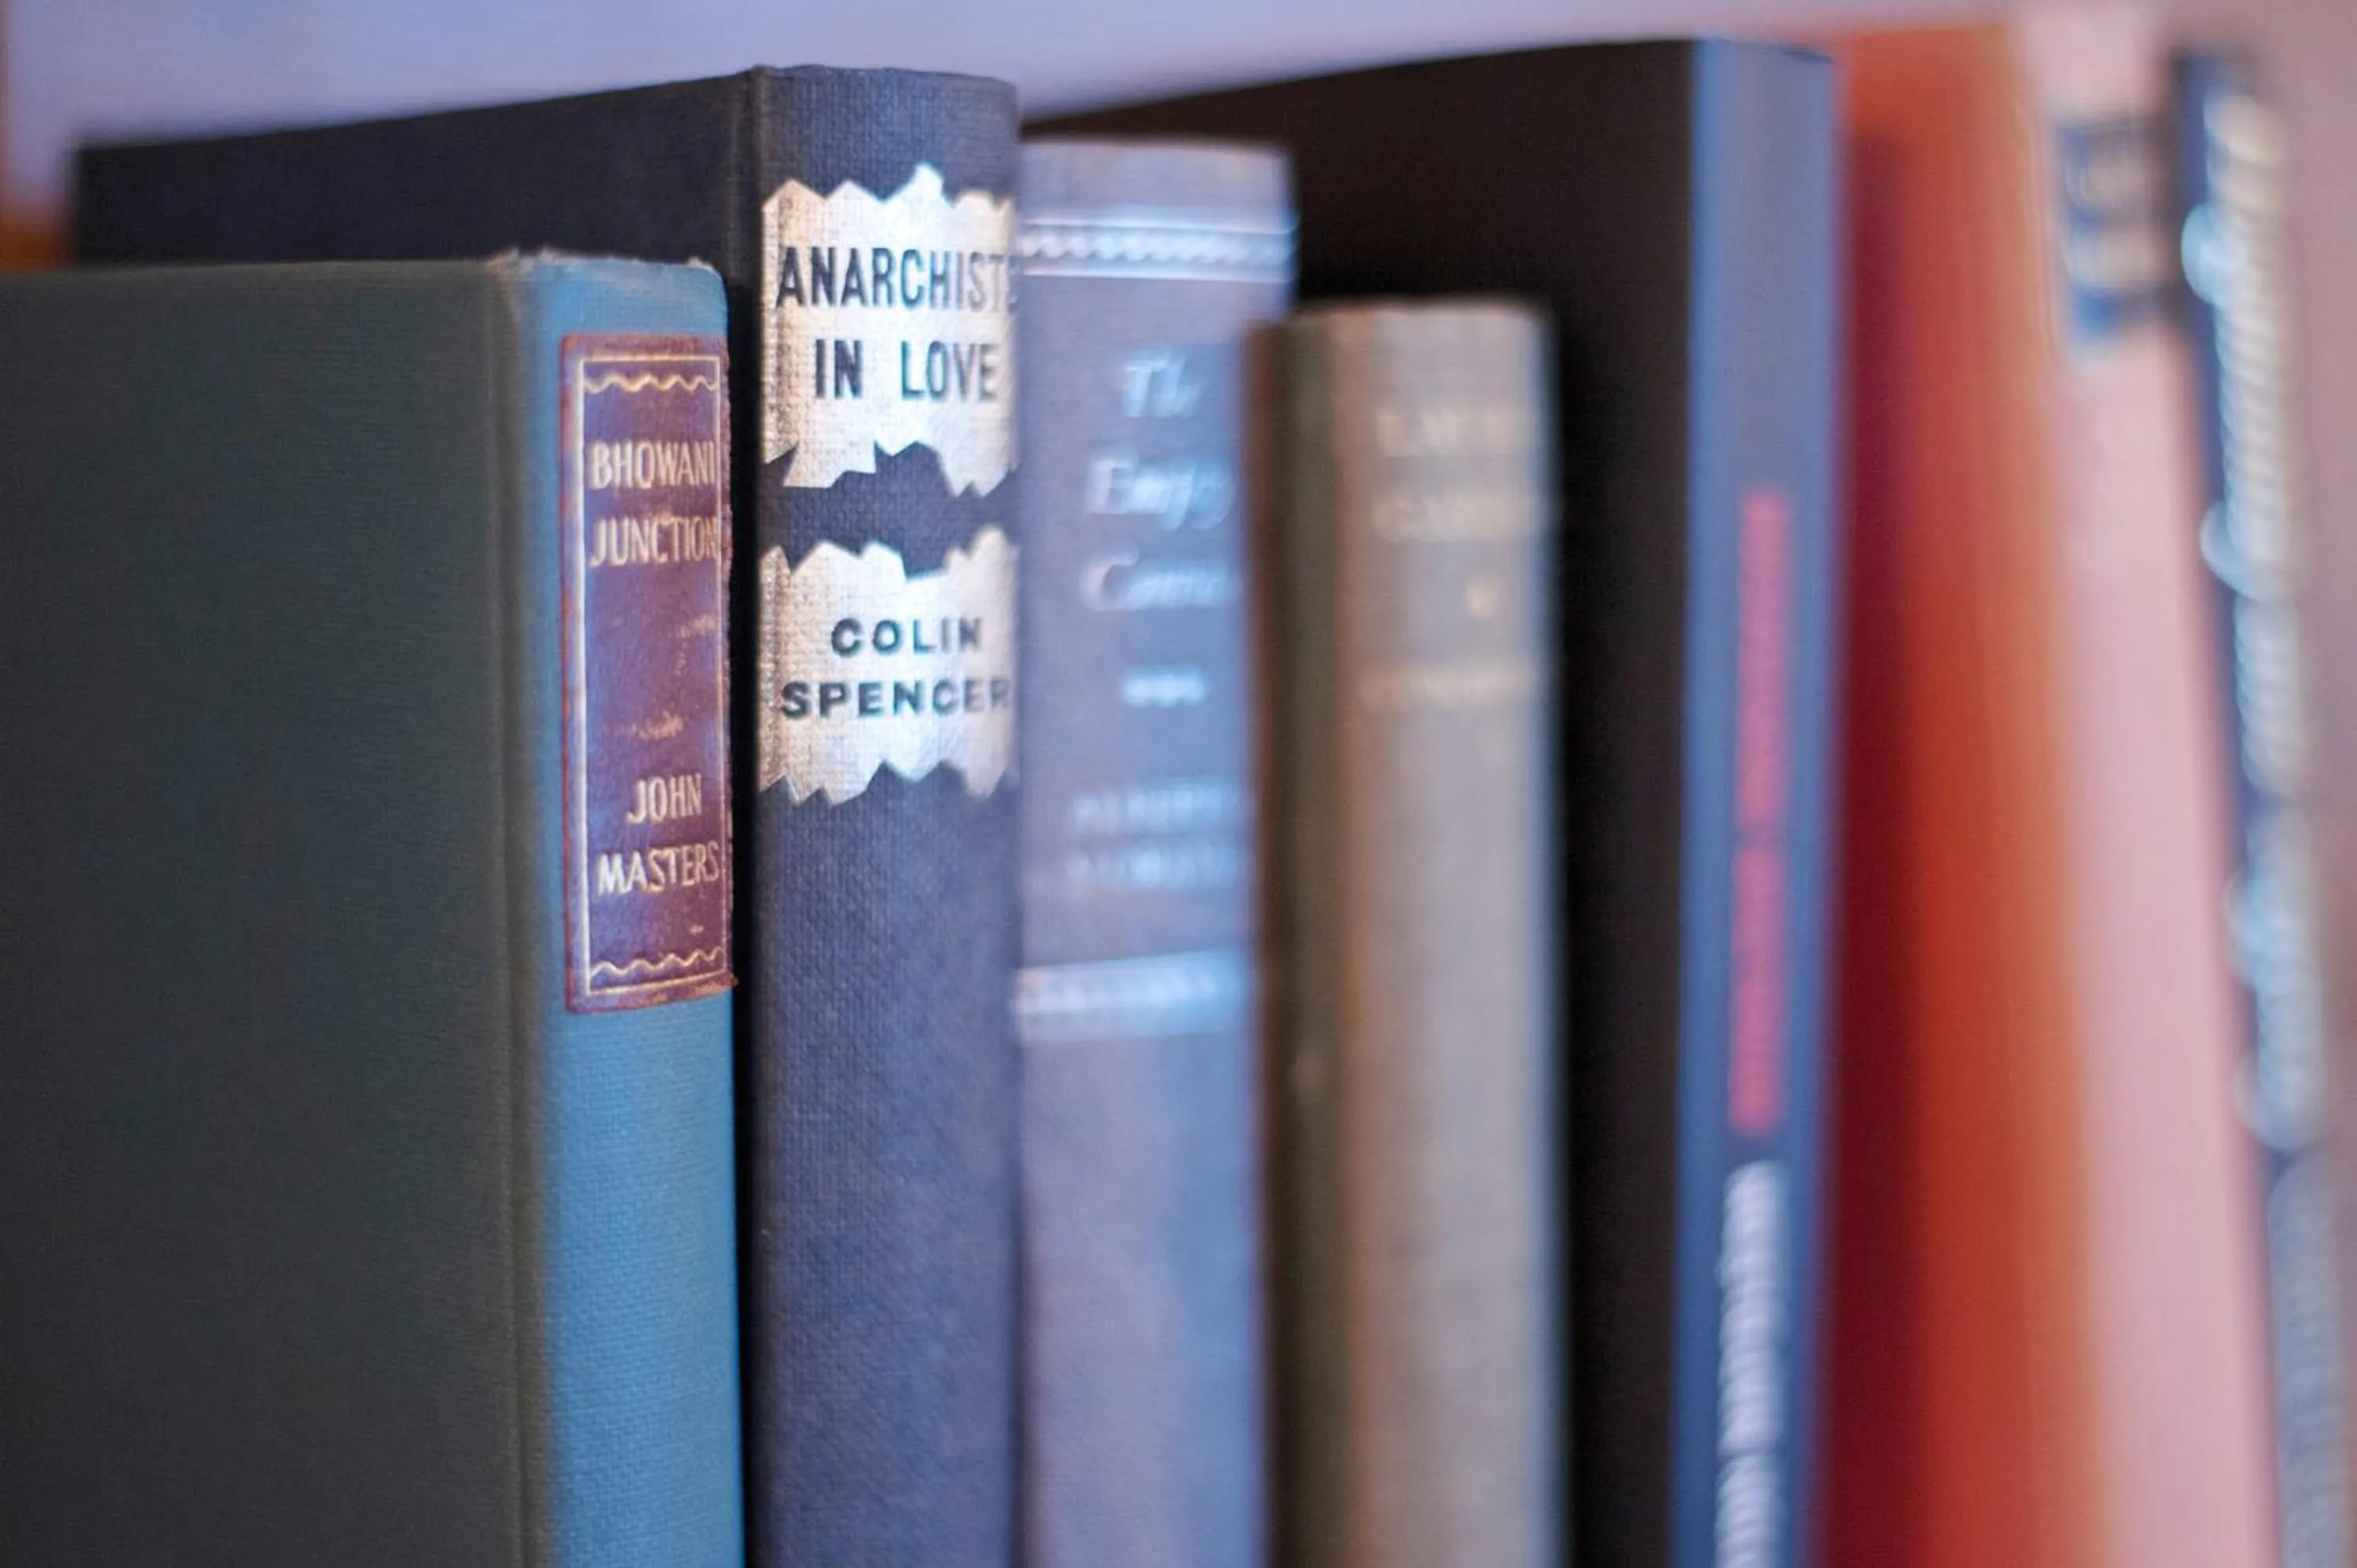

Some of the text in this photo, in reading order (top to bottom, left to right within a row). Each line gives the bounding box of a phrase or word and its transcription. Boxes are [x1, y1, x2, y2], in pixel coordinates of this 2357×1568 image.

[815, 338, 999, 403] IN LOVE
[591, 439, 717, 490] BHOWANI
[589, 515, 718, 568] JUNCTION
[830, 617, 982, 658] COLIN
[781, 679, 1013, 719] SPENCER
[628, 774, 702, 823] JOHN
[596, 843, 720, 896] MASTERS
